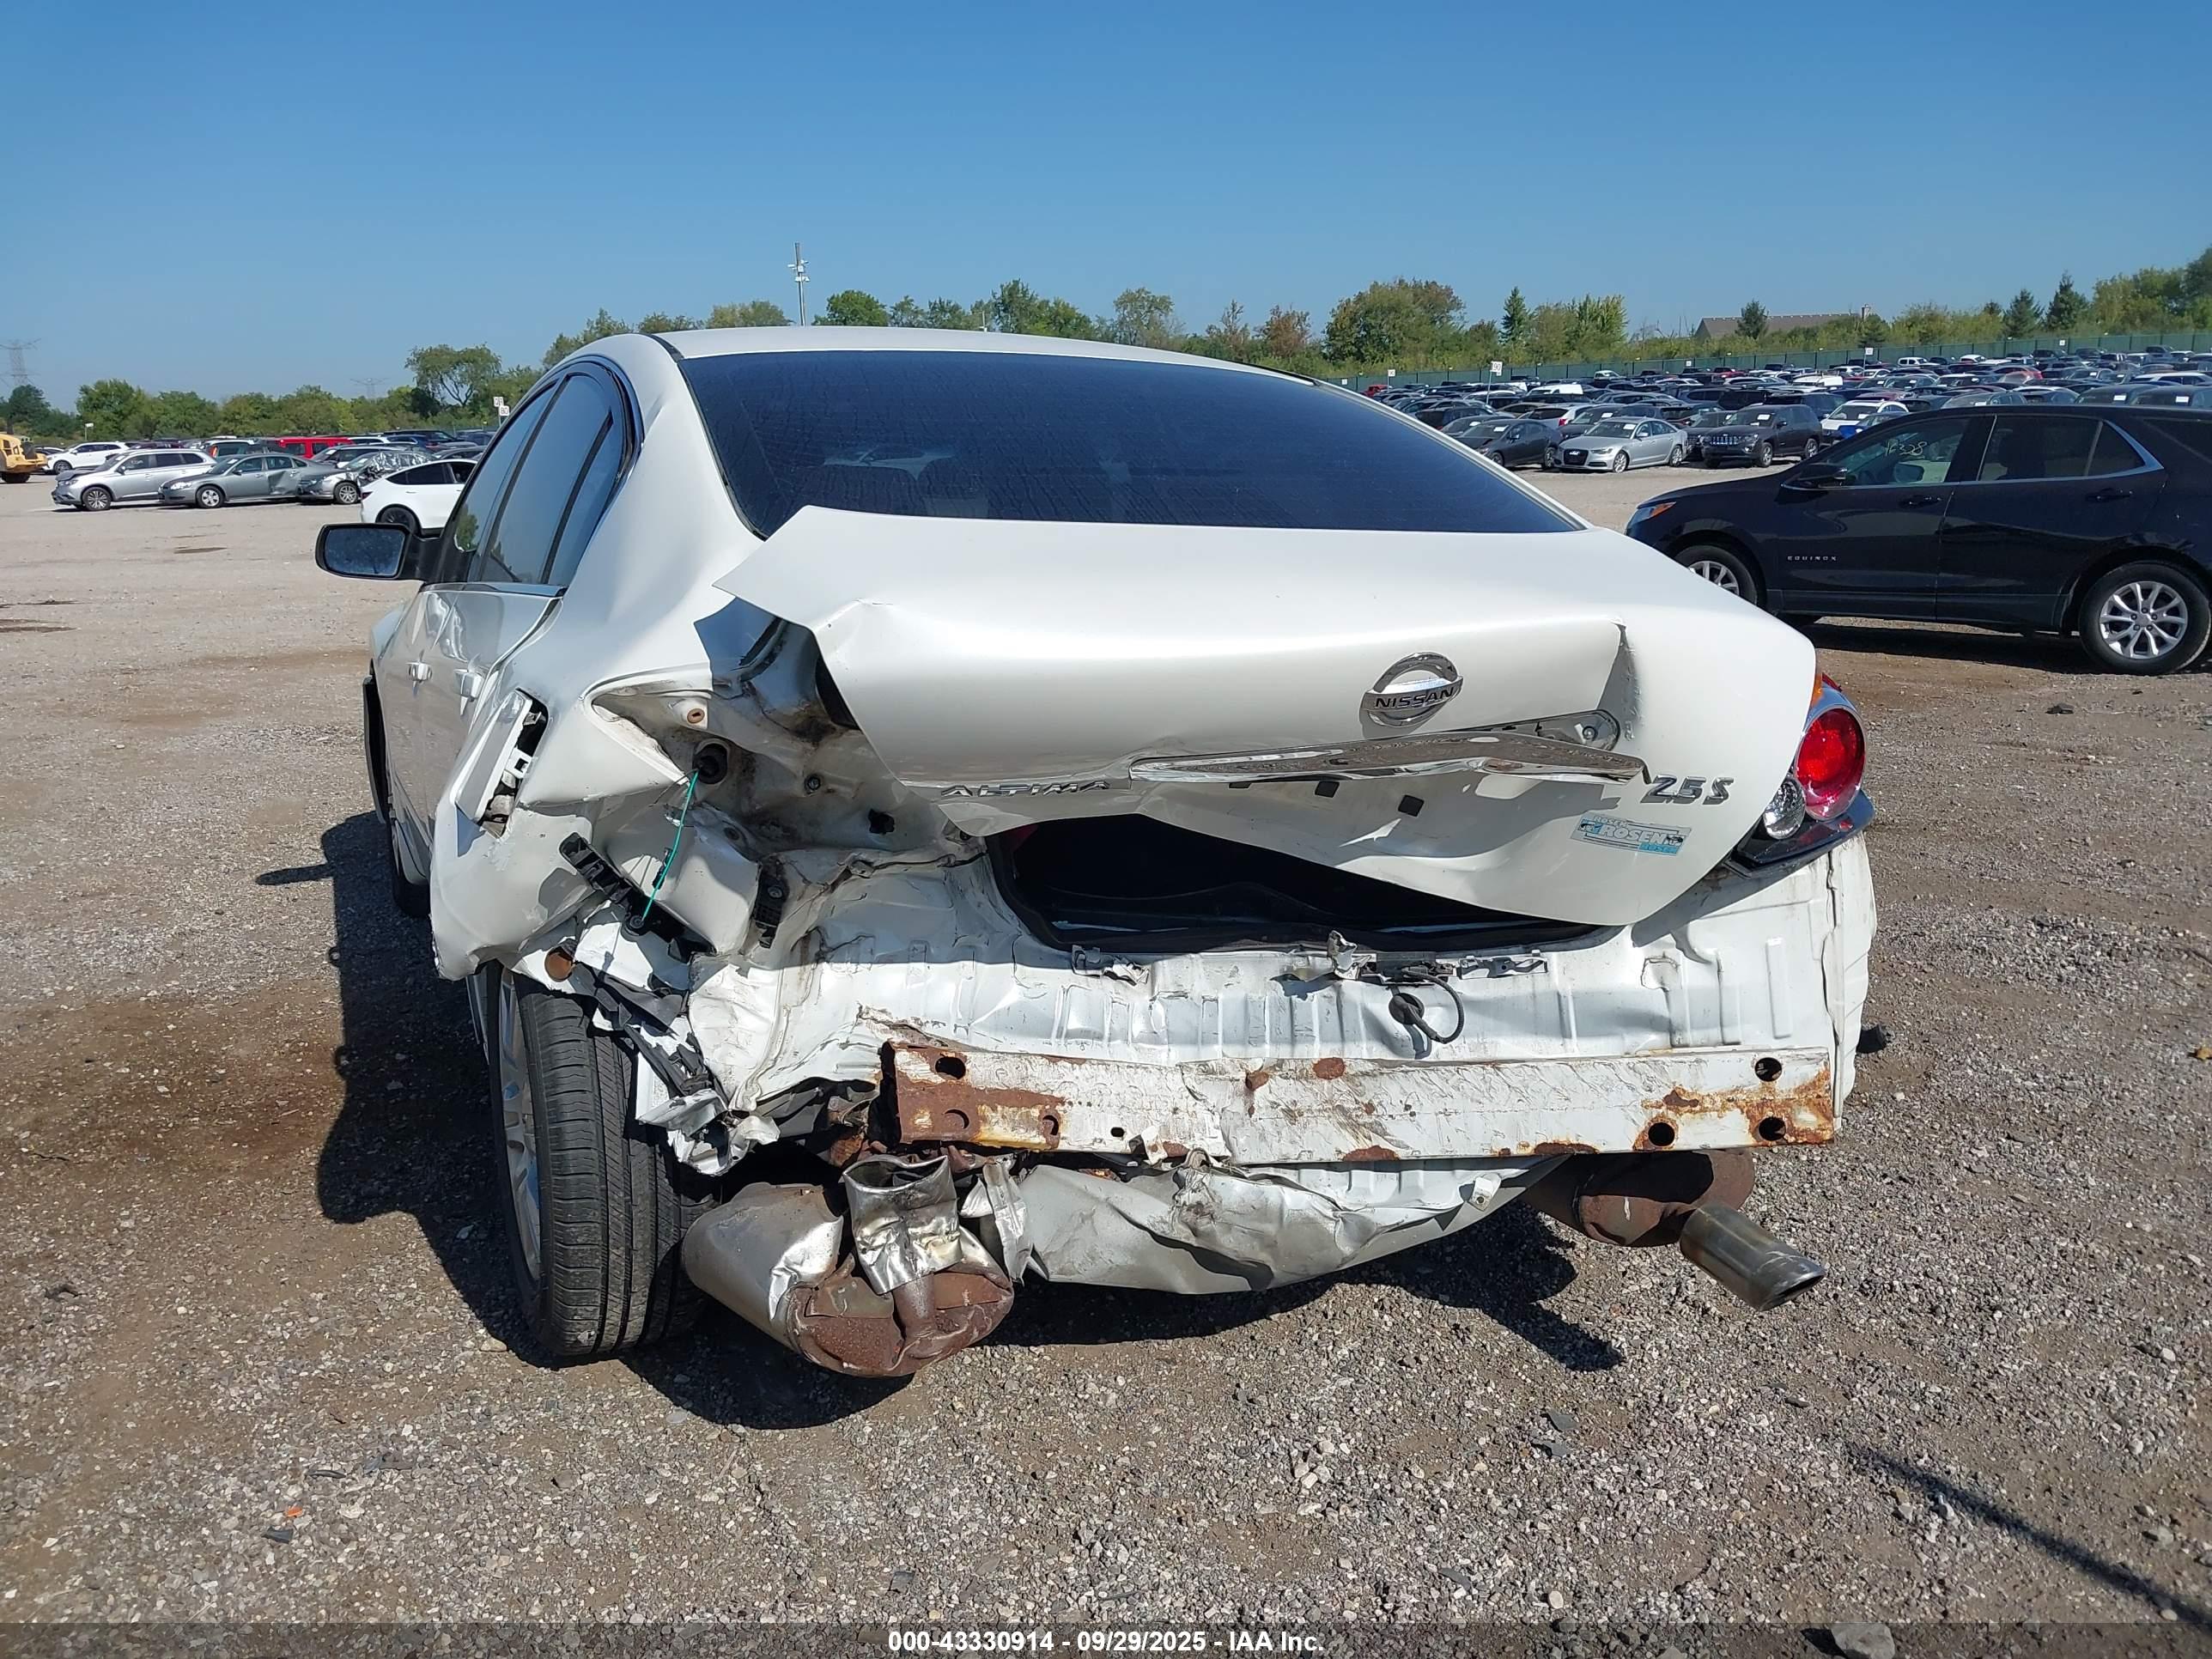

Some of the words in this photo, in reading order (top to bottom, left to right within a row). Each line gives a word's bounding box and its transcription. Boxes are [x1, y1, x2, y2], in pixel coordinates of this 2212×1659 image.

[1374, 687, 1455, 708] NISSAN
[941, 781, 1110, 798] ALTIMA
[1705, 776, 1735, 801] S
[1598, 824, 1668, 846] ROSEN
